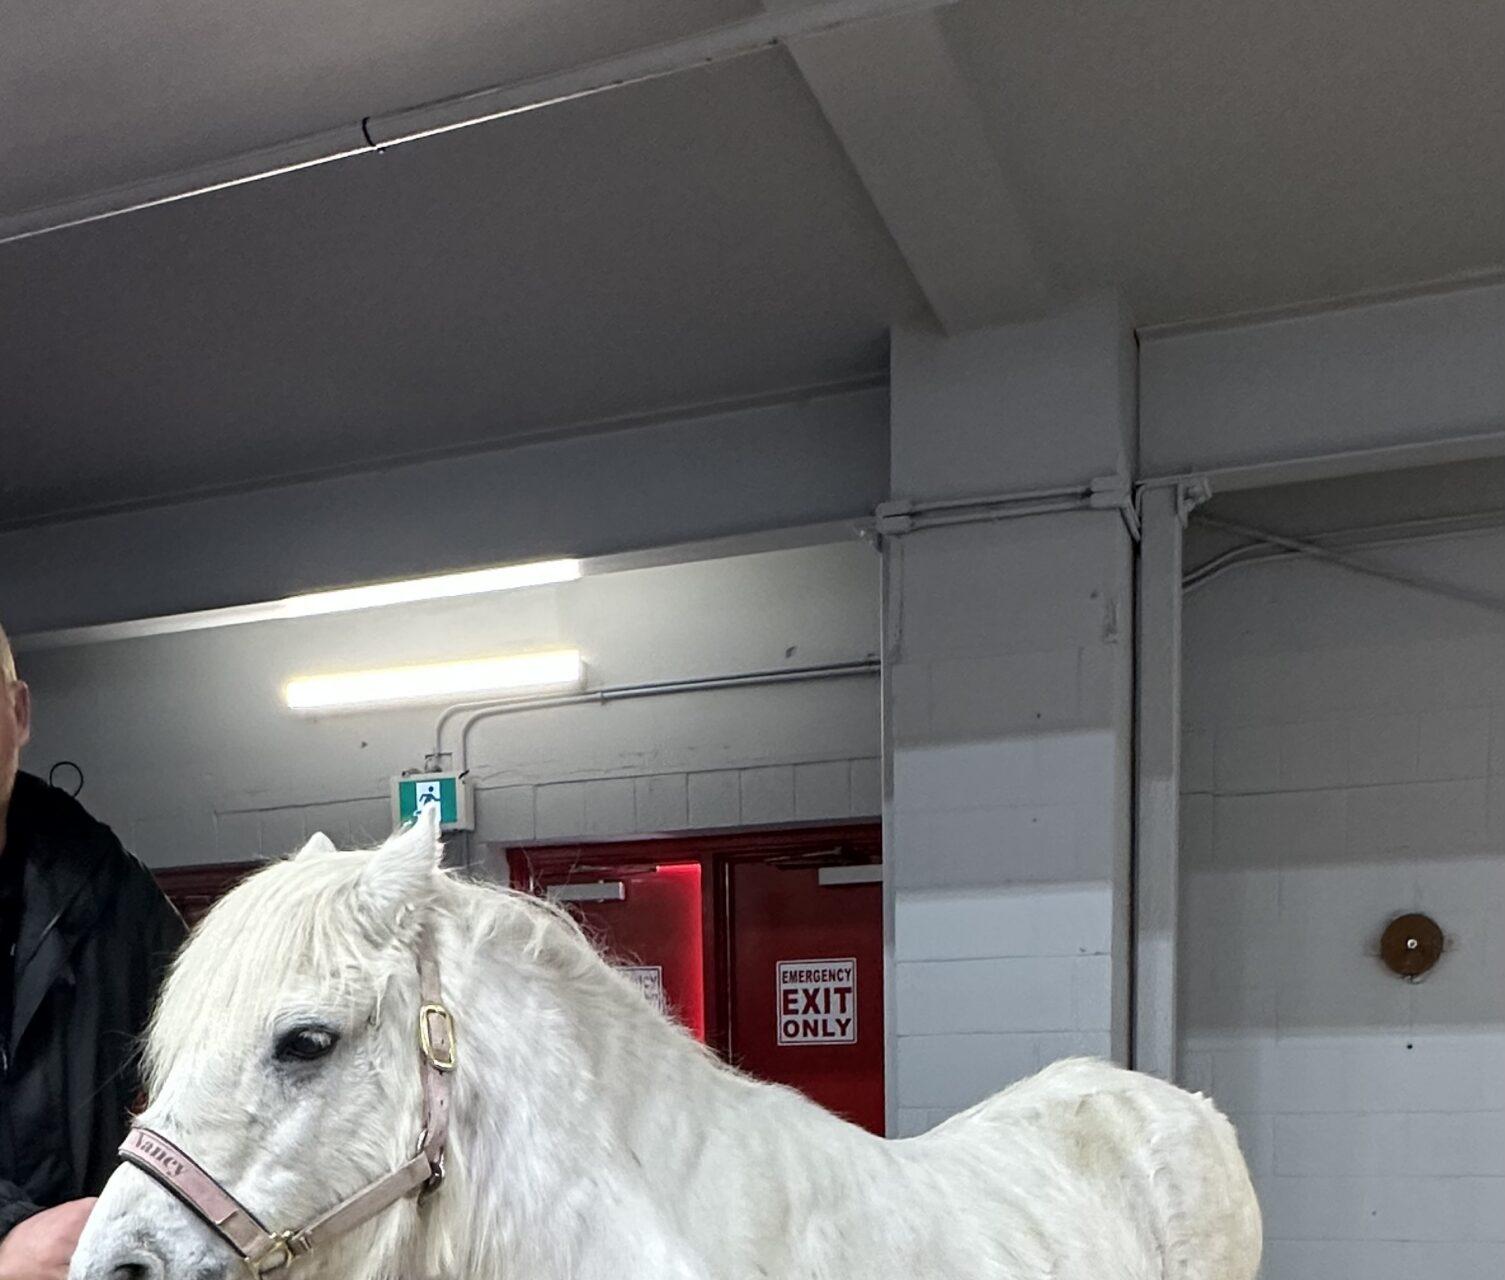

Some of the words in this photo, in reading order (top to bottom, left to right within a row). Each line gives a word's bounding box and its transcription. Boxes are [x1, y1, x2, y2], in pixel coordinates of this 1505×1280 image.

[782, 968, 851, 983] EMERGENCY
[783, 987, 851, 1015] EXIT
[783, 1018, 851, 1037] ONLY
